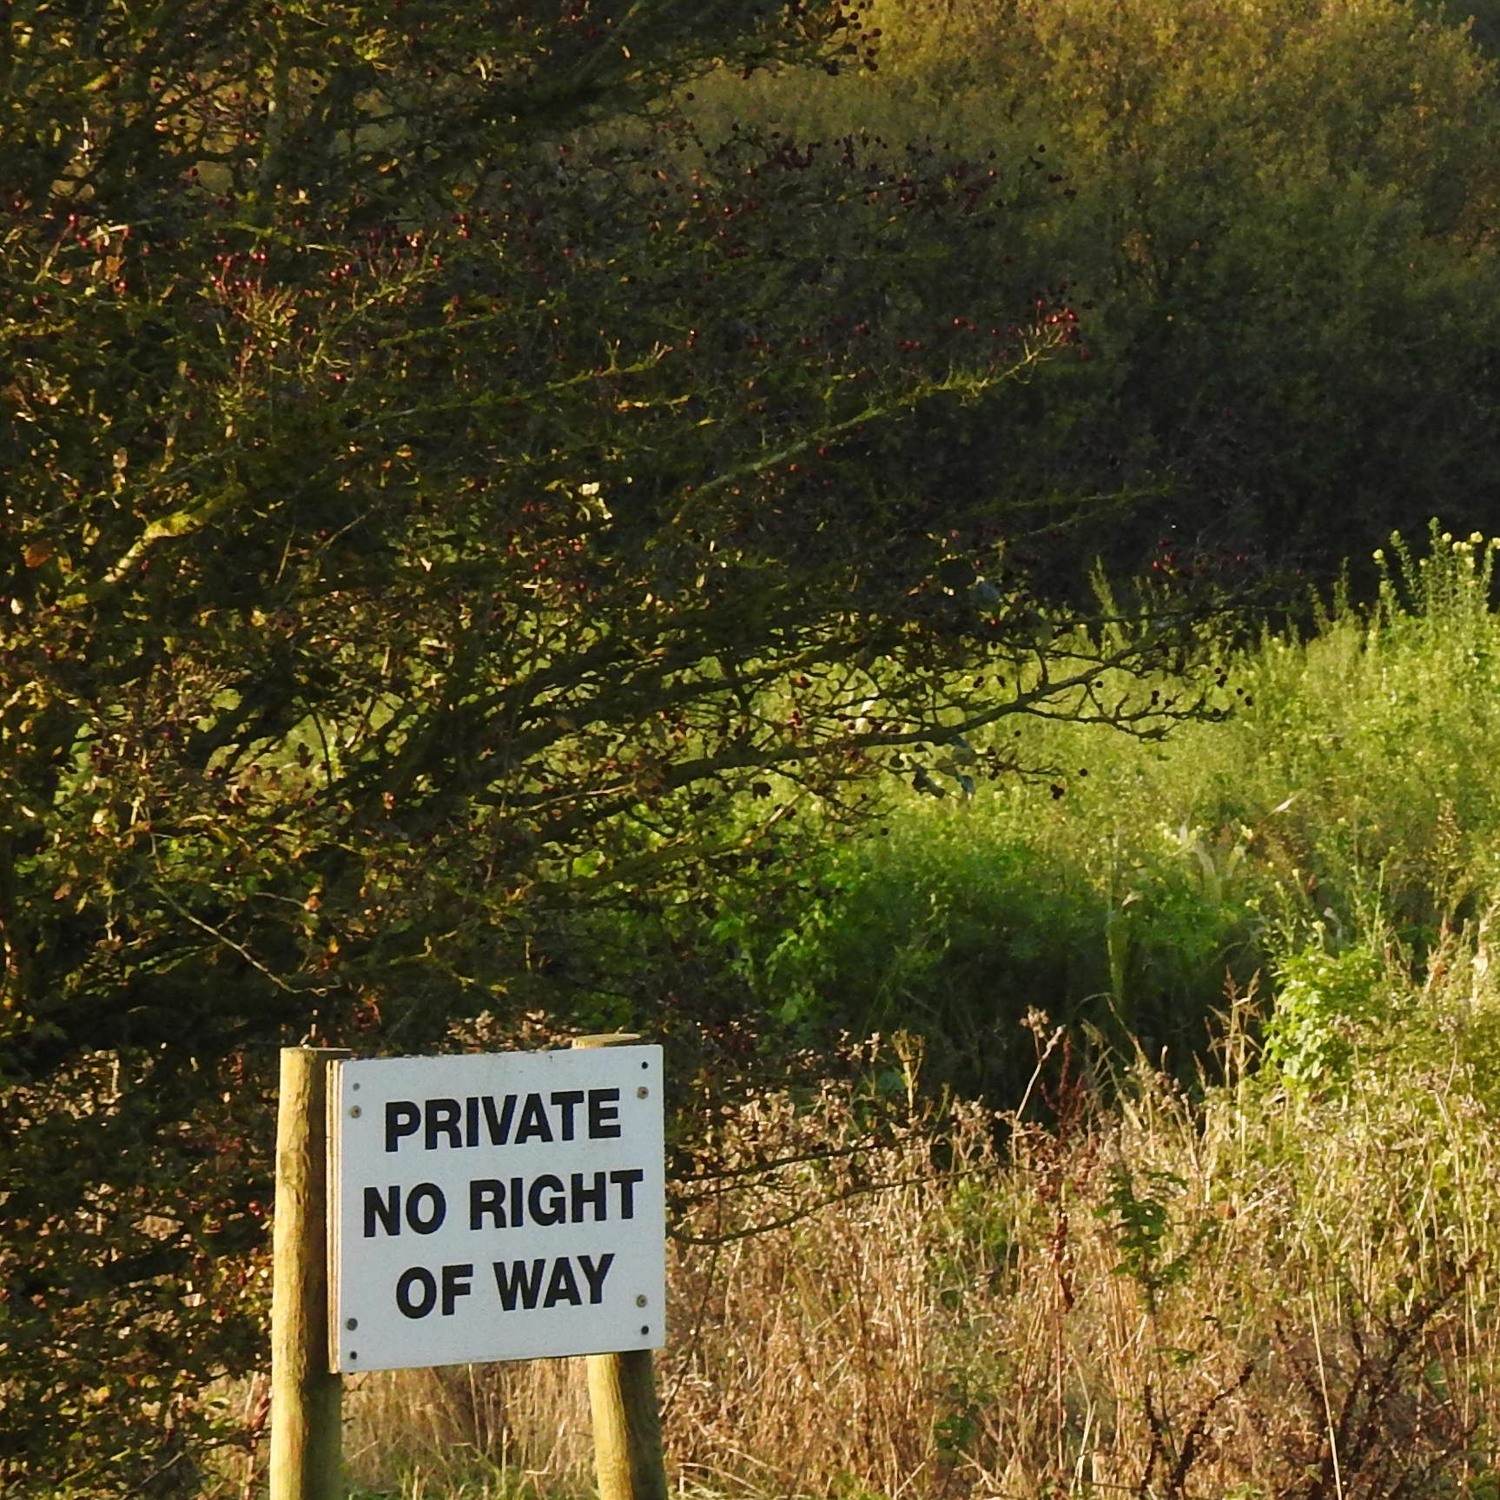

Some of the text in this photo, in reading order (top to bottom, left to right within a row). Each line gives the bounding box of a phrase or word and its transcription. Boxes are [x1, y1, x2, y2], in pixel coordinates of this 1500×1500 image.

[384, 1087, 622, 1153] PRIVATE
[363, 1168, 644, 1238] NO RIGHT
[395, 1252, 616, 1320] OF WAY
